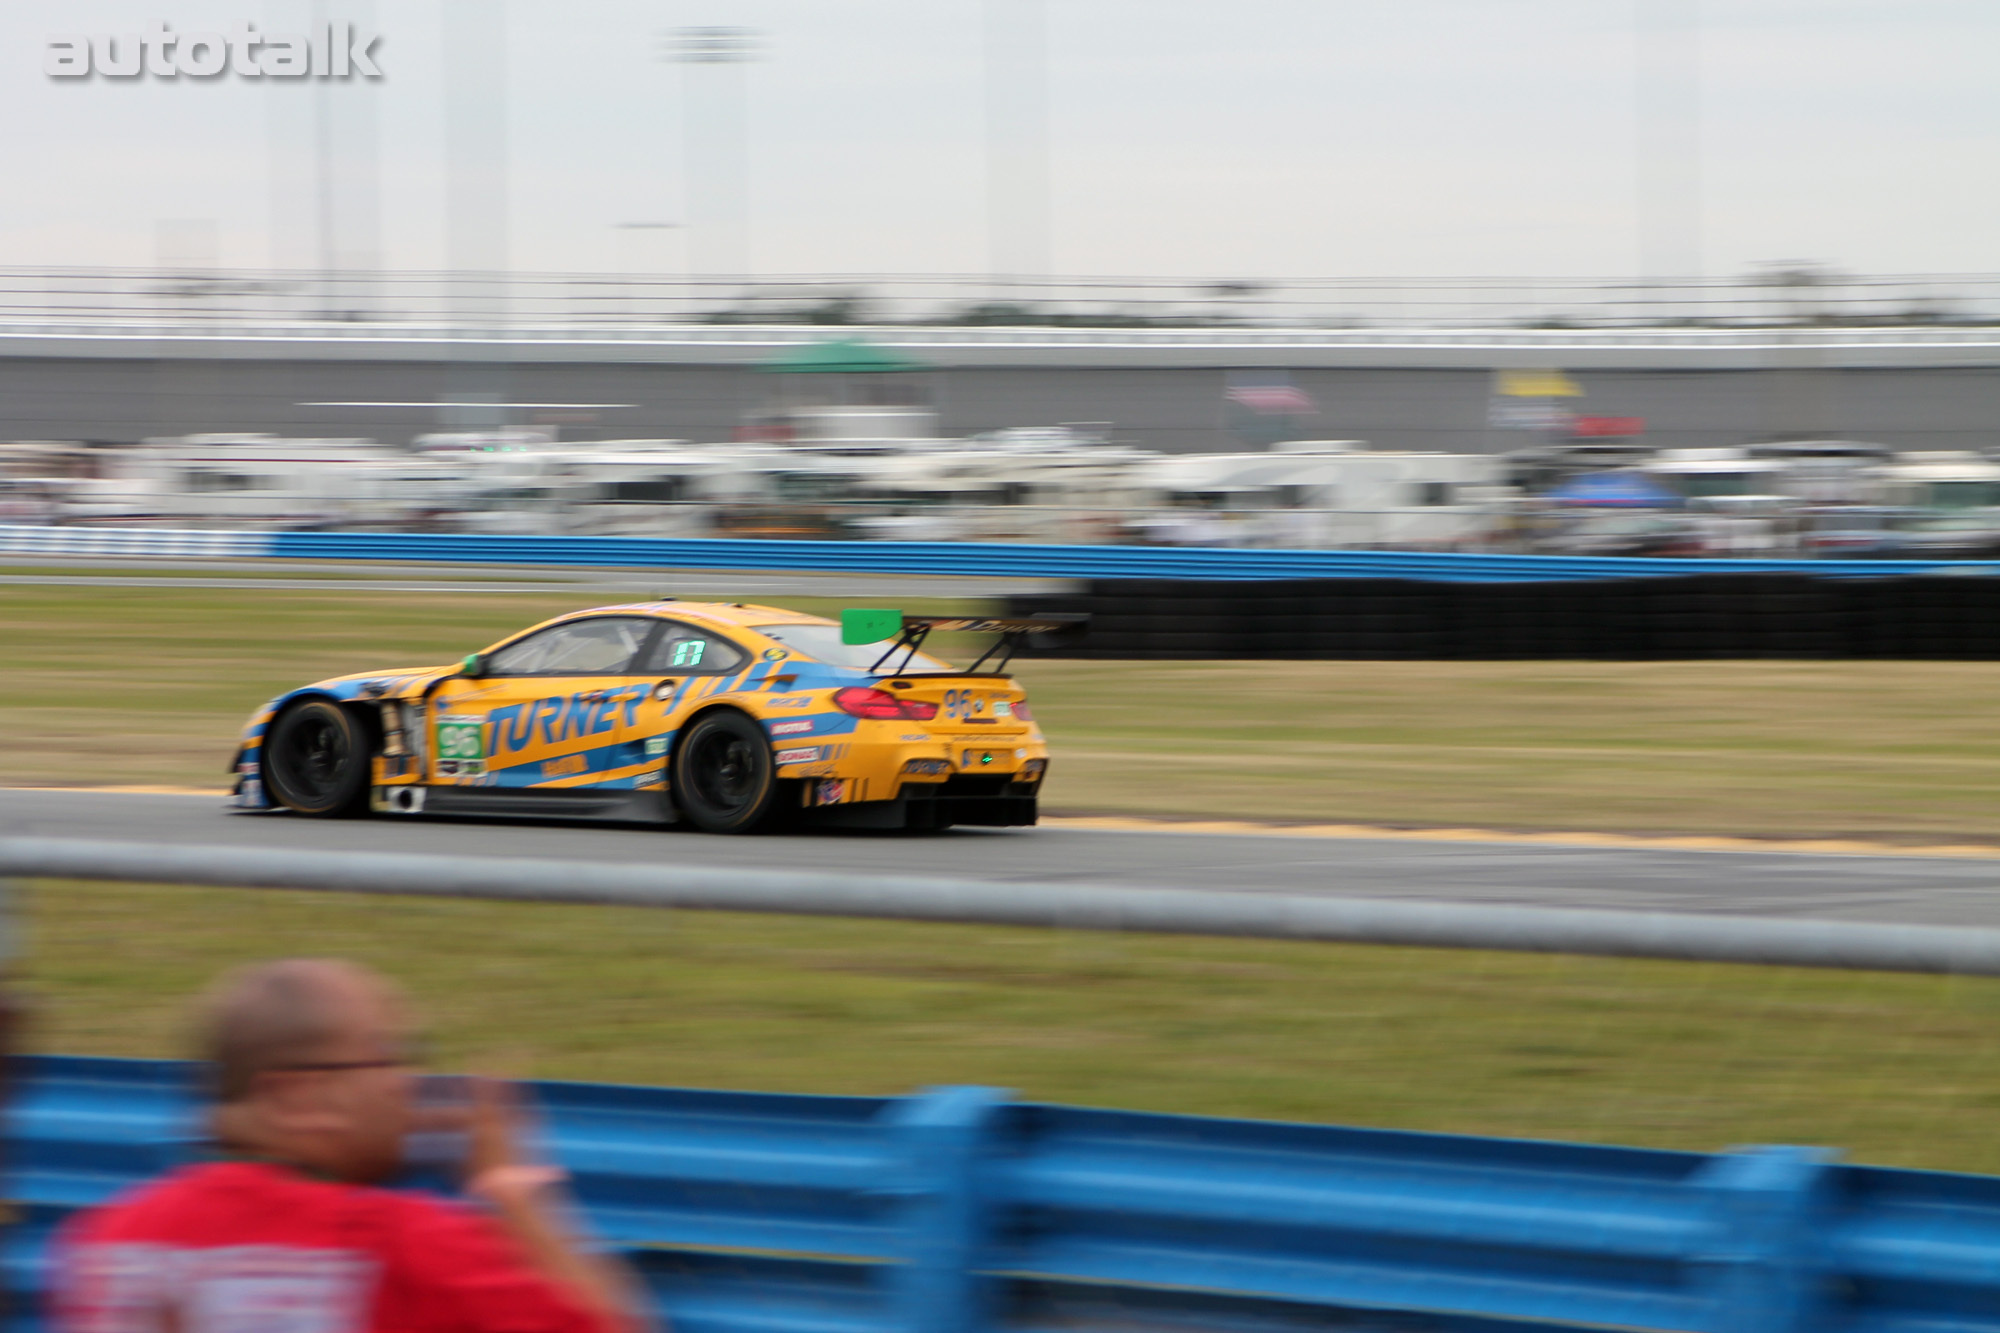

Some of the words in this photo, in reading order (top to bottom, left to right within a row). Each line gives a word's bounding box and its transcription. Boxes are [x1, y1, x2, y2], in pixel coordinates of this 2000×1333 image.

[944, 689, 973, 718] 96
[485, 683, 654, 757] TURNER
[438, 725, 480, 757] 96
